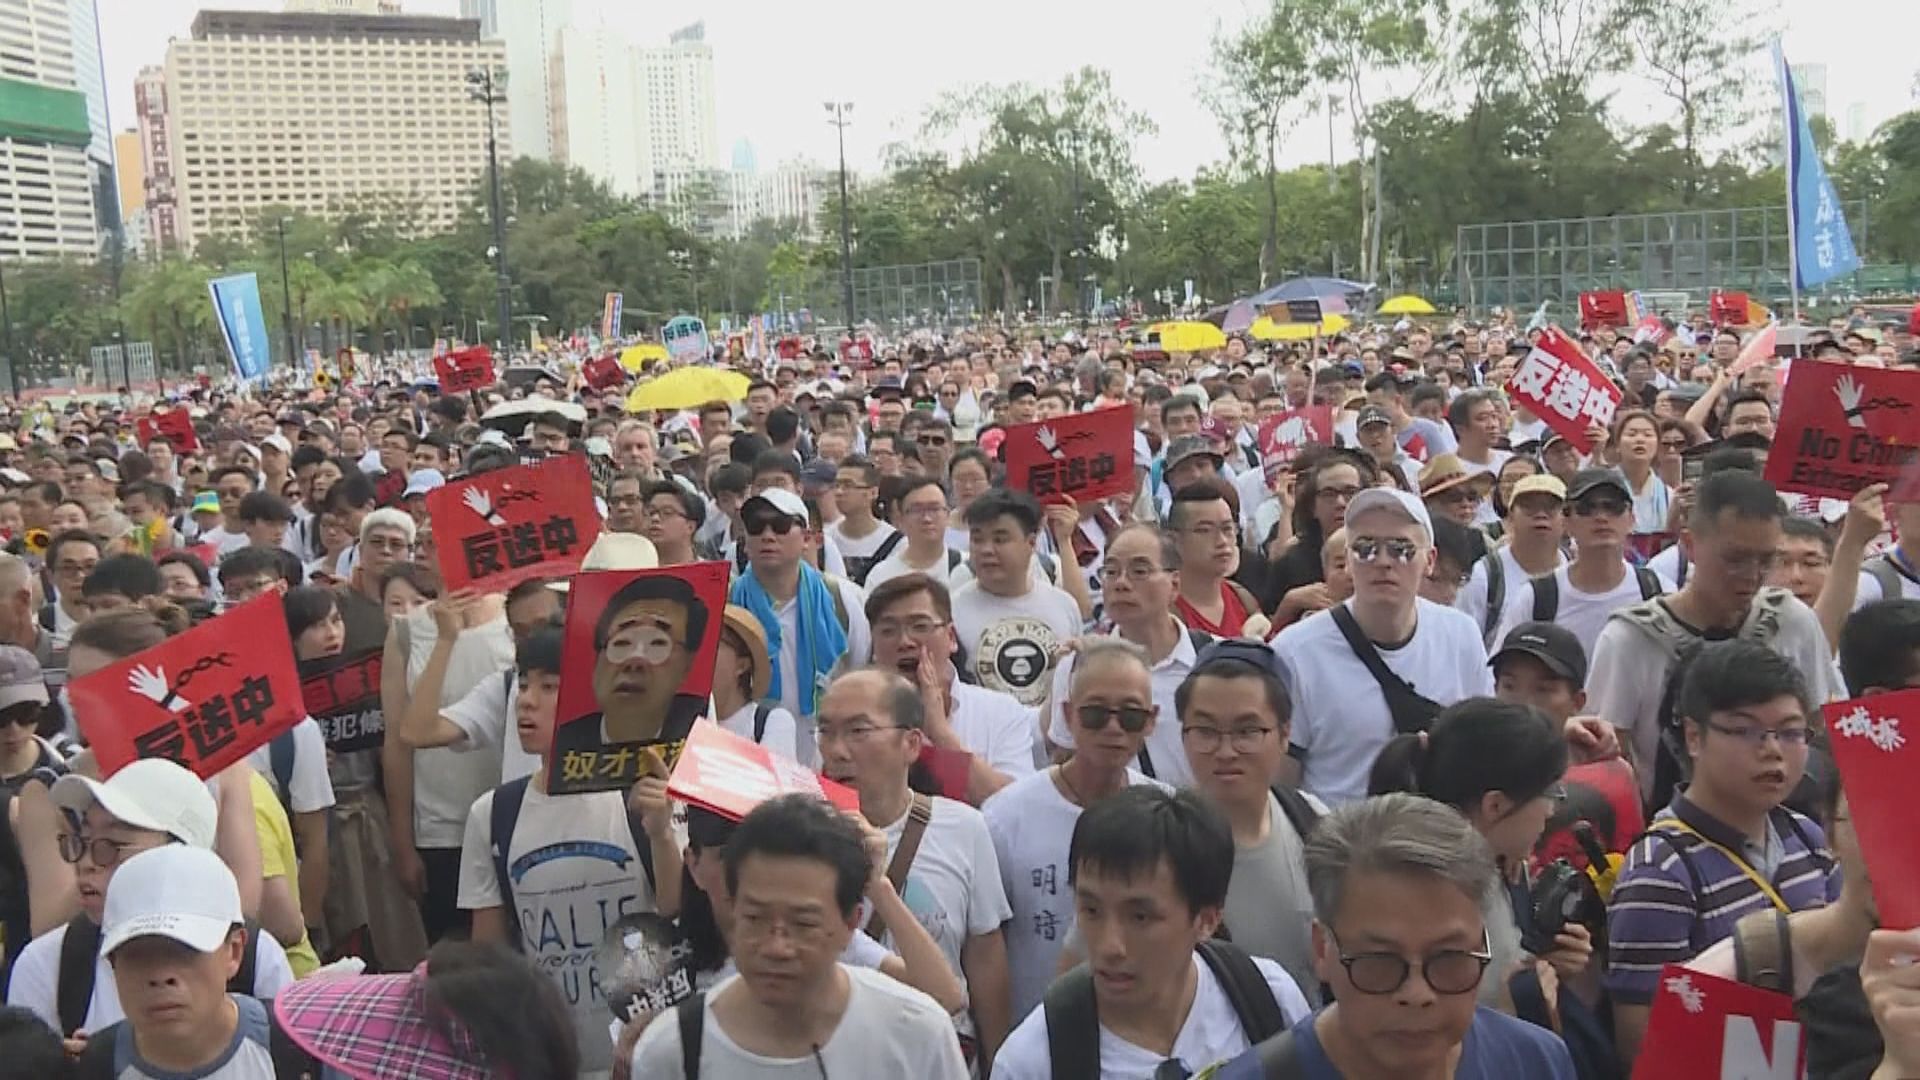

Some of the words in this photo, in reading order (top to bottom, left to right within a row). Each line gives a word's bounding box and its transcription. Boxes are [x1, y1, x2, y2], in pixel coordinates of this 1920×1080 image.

[1512, 346, 1617, 425] 反送中
[1028, 453, 1115, 497] 反送中
[1799, 427, 1841, 461] No
[463, 515, 577, 579] 反送中
[134, 675, 274, 768] 反送中
